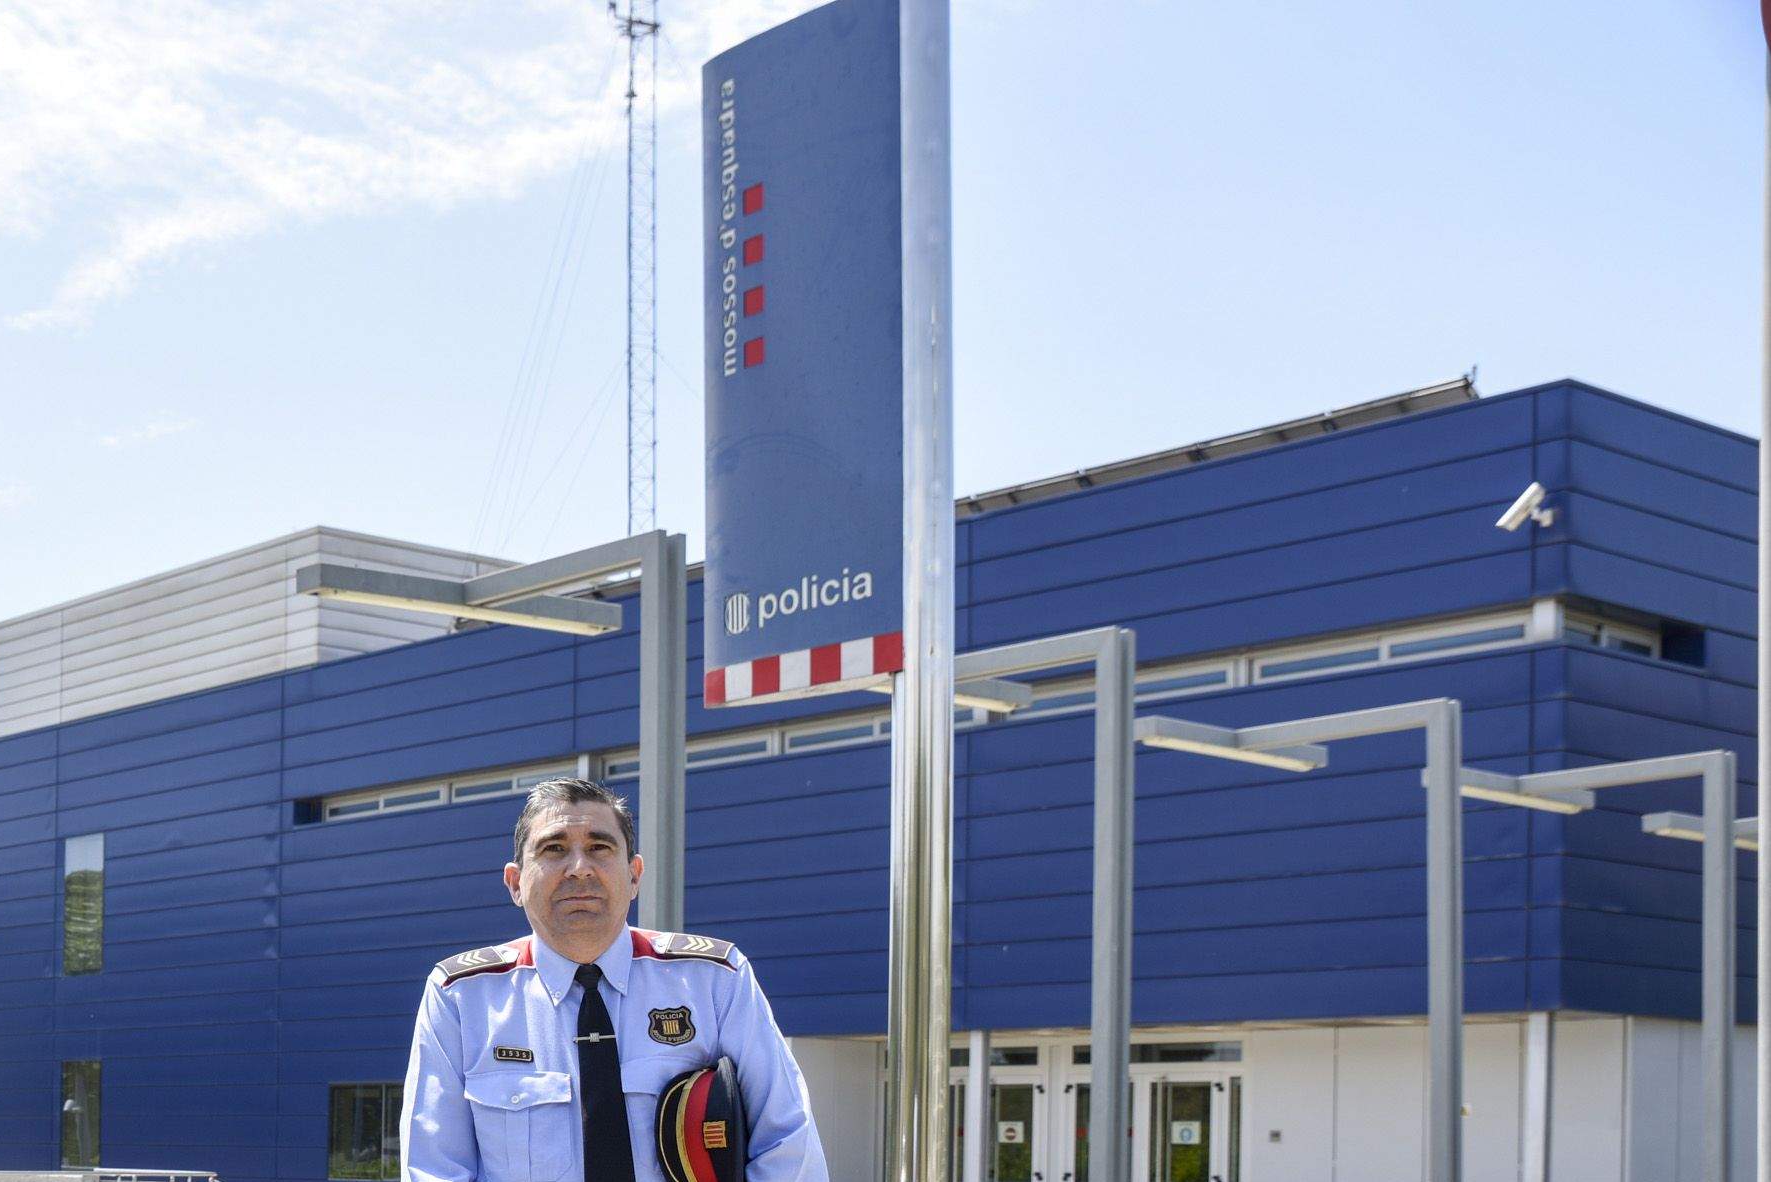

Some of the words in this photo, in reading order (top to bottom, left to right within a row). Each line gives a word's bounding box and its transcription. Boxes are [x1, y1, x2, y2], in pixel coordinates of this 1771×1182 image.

[718, 78, 739, 250] d'esquadra
[722, 256, 737, 377] mossos
[758, 567, 873, 628] policia
